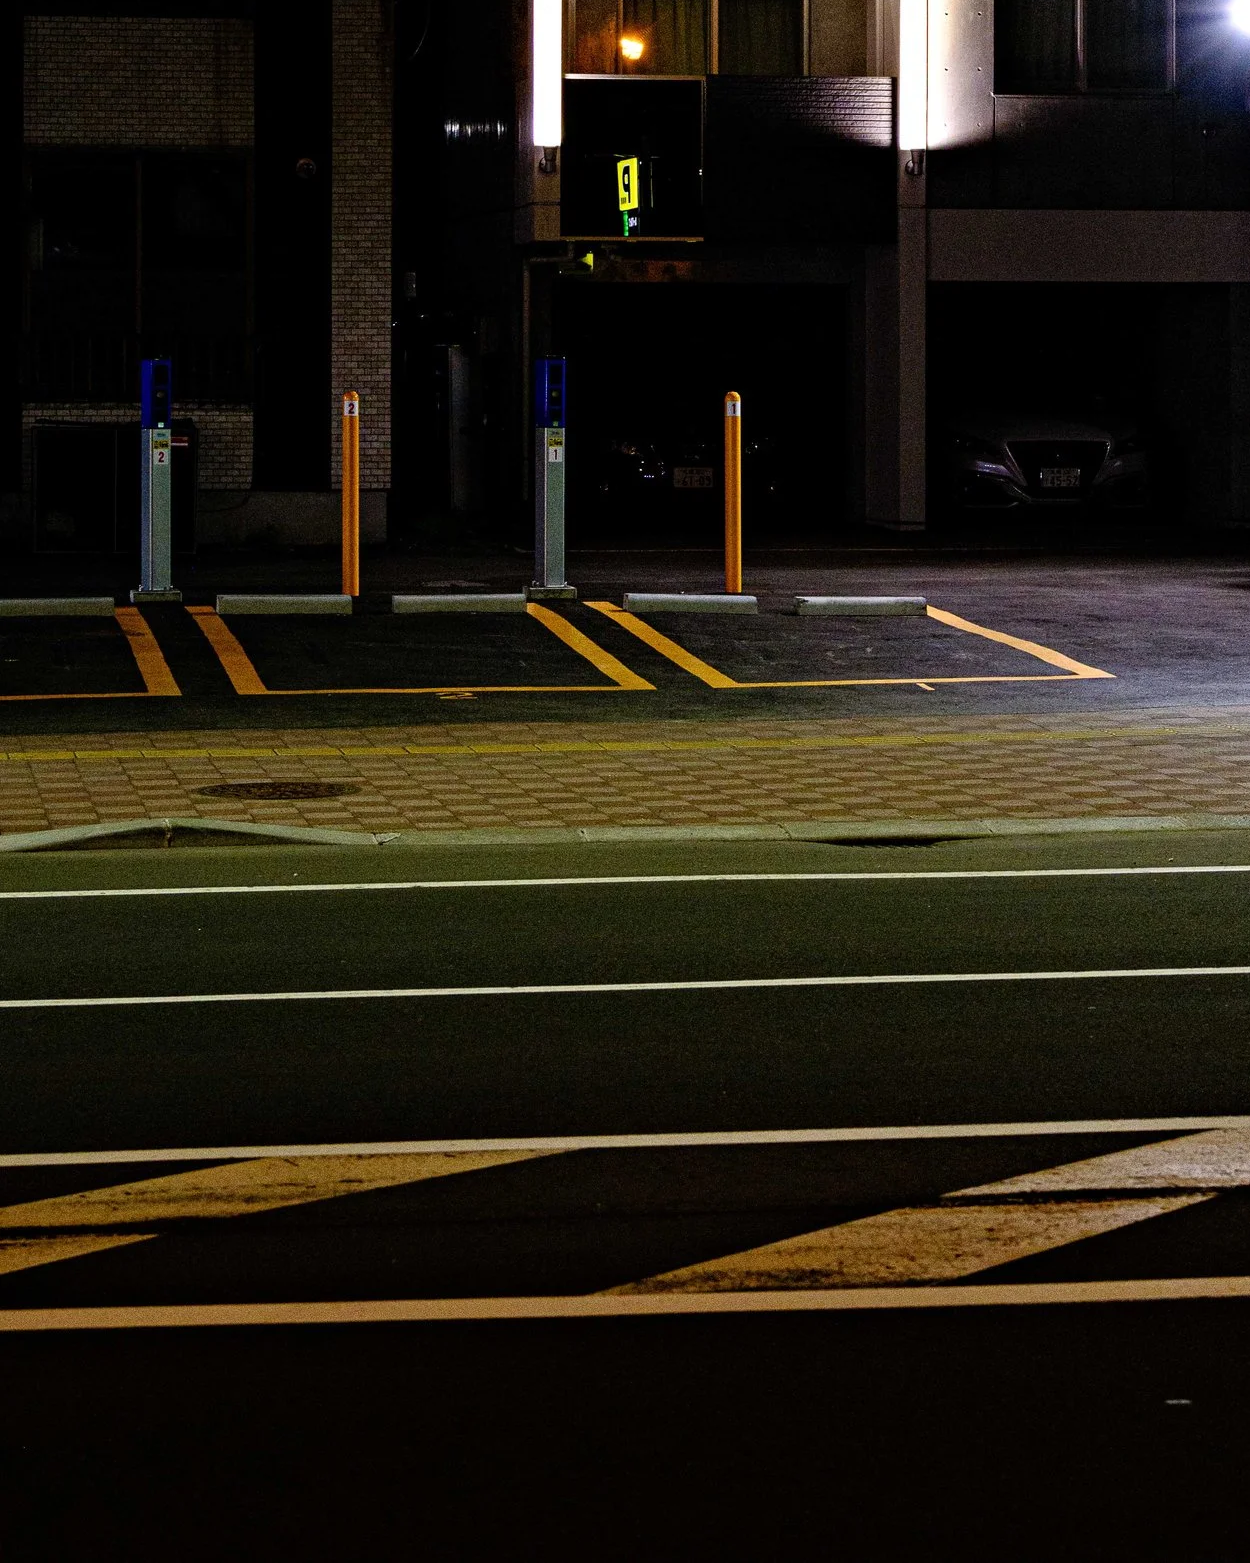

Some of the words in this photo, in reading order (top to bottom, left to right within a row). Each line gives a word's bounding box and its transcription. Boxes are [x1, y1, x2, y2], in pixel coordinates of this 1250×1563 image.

[348, 402, 355, 414] 2
[731, 403, 736, 414] 1
[158, 451, 165, 463] 2
